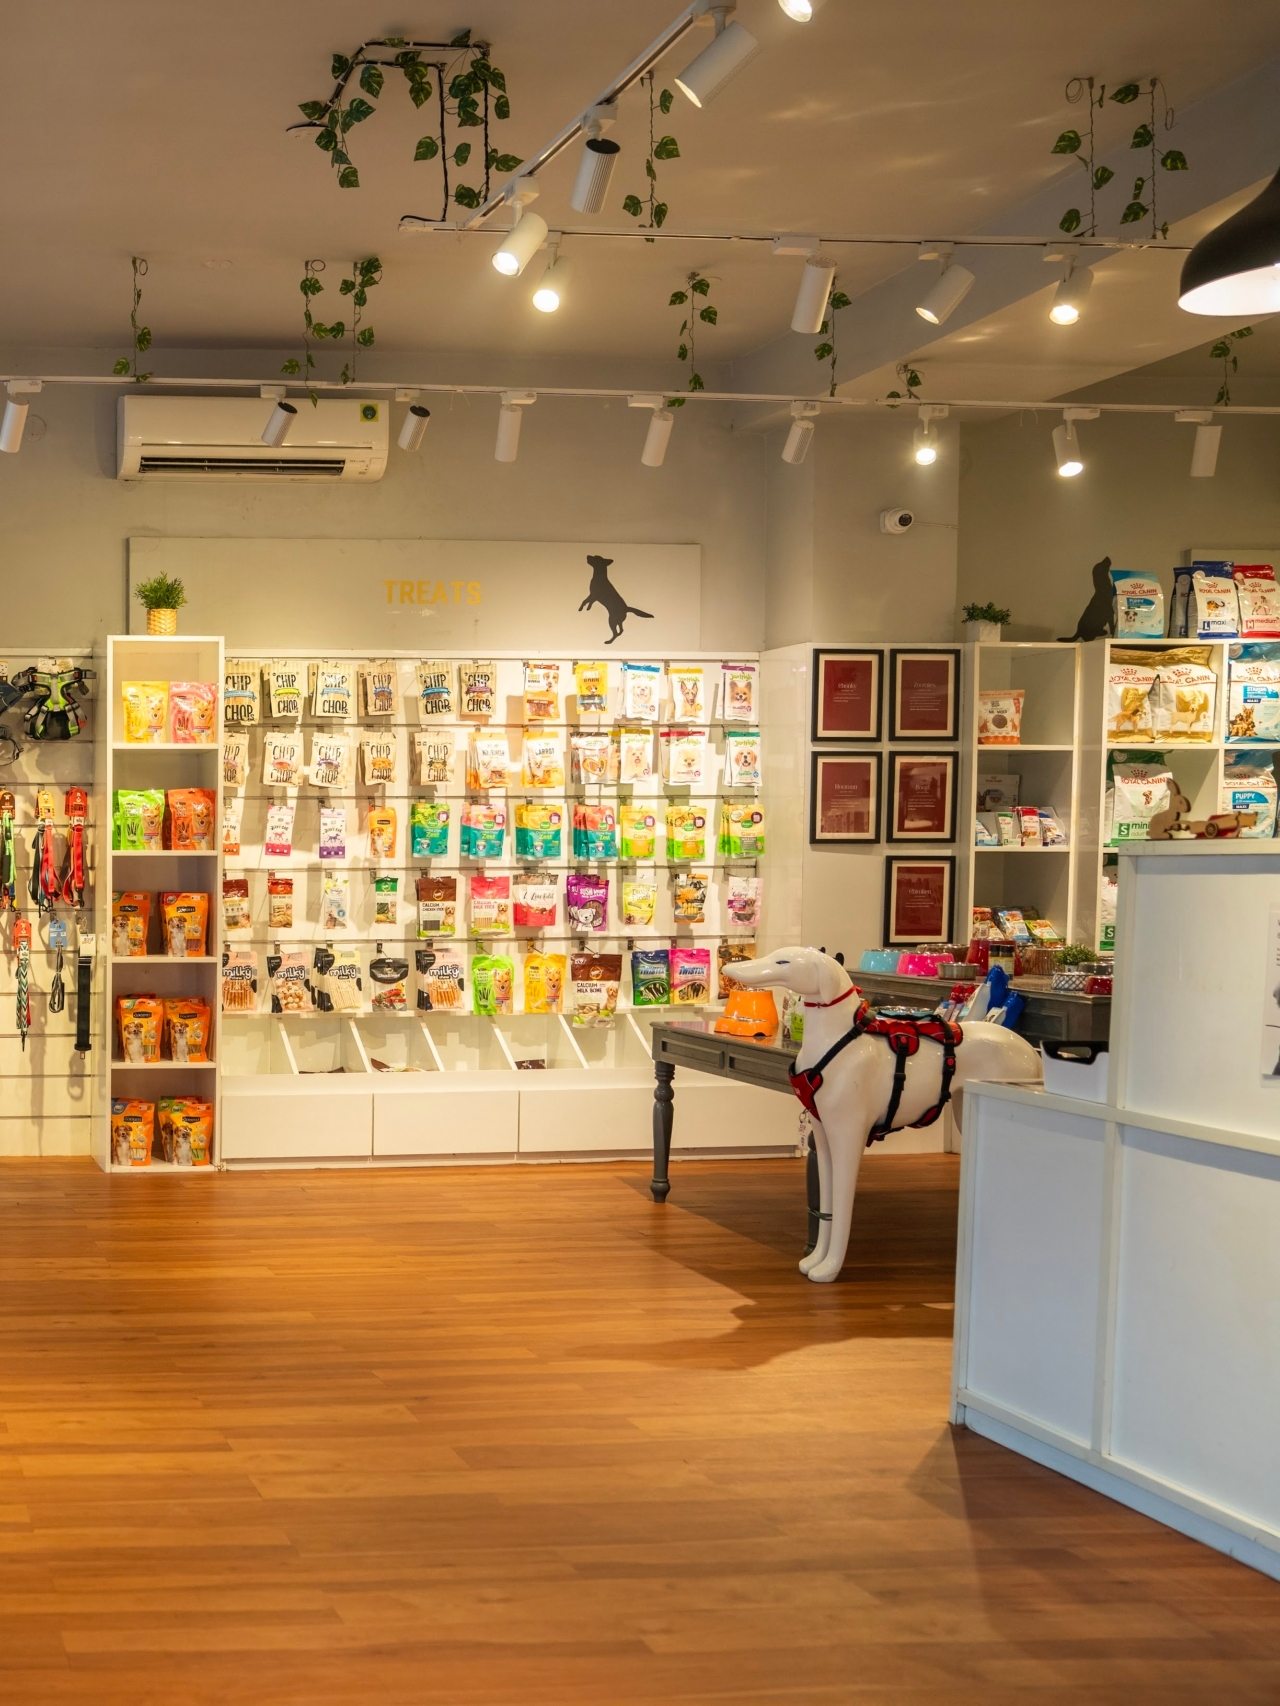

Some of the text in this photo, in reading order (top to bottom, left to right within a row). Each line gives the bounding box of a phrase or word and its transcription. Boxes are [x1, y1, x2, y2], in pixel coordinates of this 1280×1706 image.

[382, 580, 481, 605] TREATS
[225, 675, 251, 691] CHIP
[276, 674, 296, 688] CHIP
[373, 674, 391, 689] CHIP
[424, 674, 446, 688] CHIP
[1185, 675, 1210, 683] CANIN
[223, 745, 240, 760] HIP
[273, 746, 294, 760] CHIP
[319, 746, 341, 760] CHIP
[371, 745, 390, 759] CHIP
[428, 745, 448, 760] CHIP
[1120, 825, 1128, 835] S
[222, 965, 252, 979] milky
[276, 965, 305, 979] milky
[329, 964, 357, 979] milky
[429, 964, 459, 979] milky
[679, 966, 706, 975] TWISTIX
